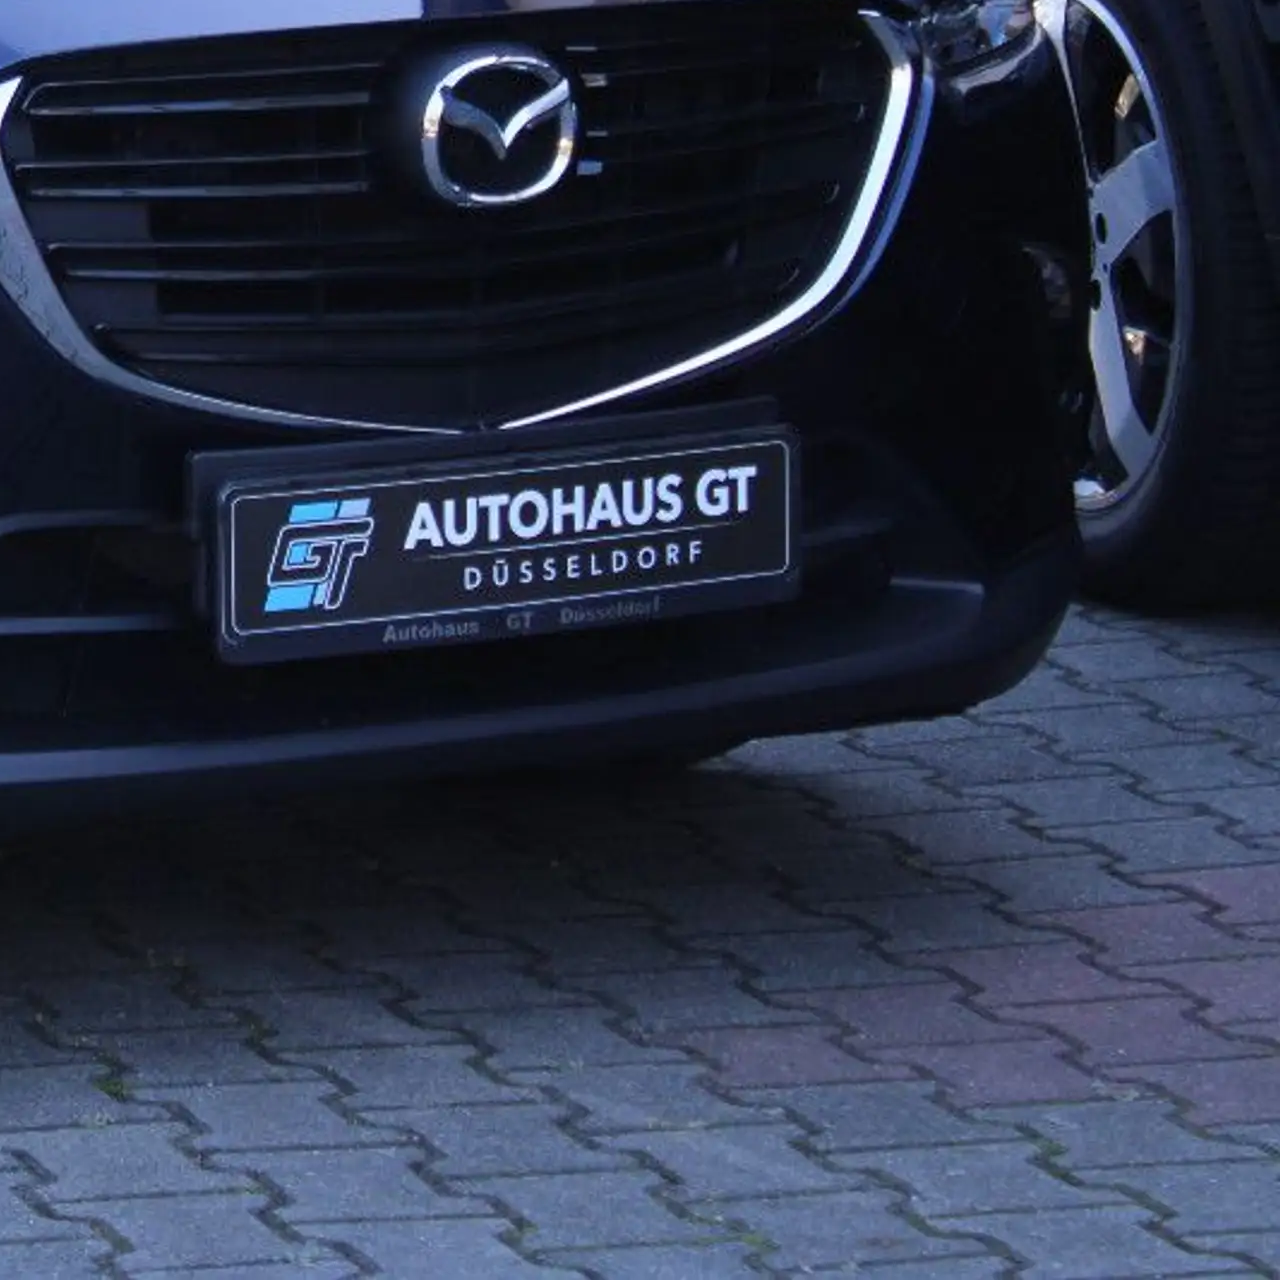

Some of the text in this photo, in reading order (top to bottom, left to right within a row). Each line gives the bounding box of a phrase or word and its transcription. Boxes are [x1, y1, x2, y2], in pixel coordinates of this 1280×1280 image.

[402, 463, 759, 551] AUTOHAUS GT
[462, 539, 704, 592] DÜSSELDORF
[381, 619, 481, 644] Autohaus
[505, 610, 537, 631] GT
